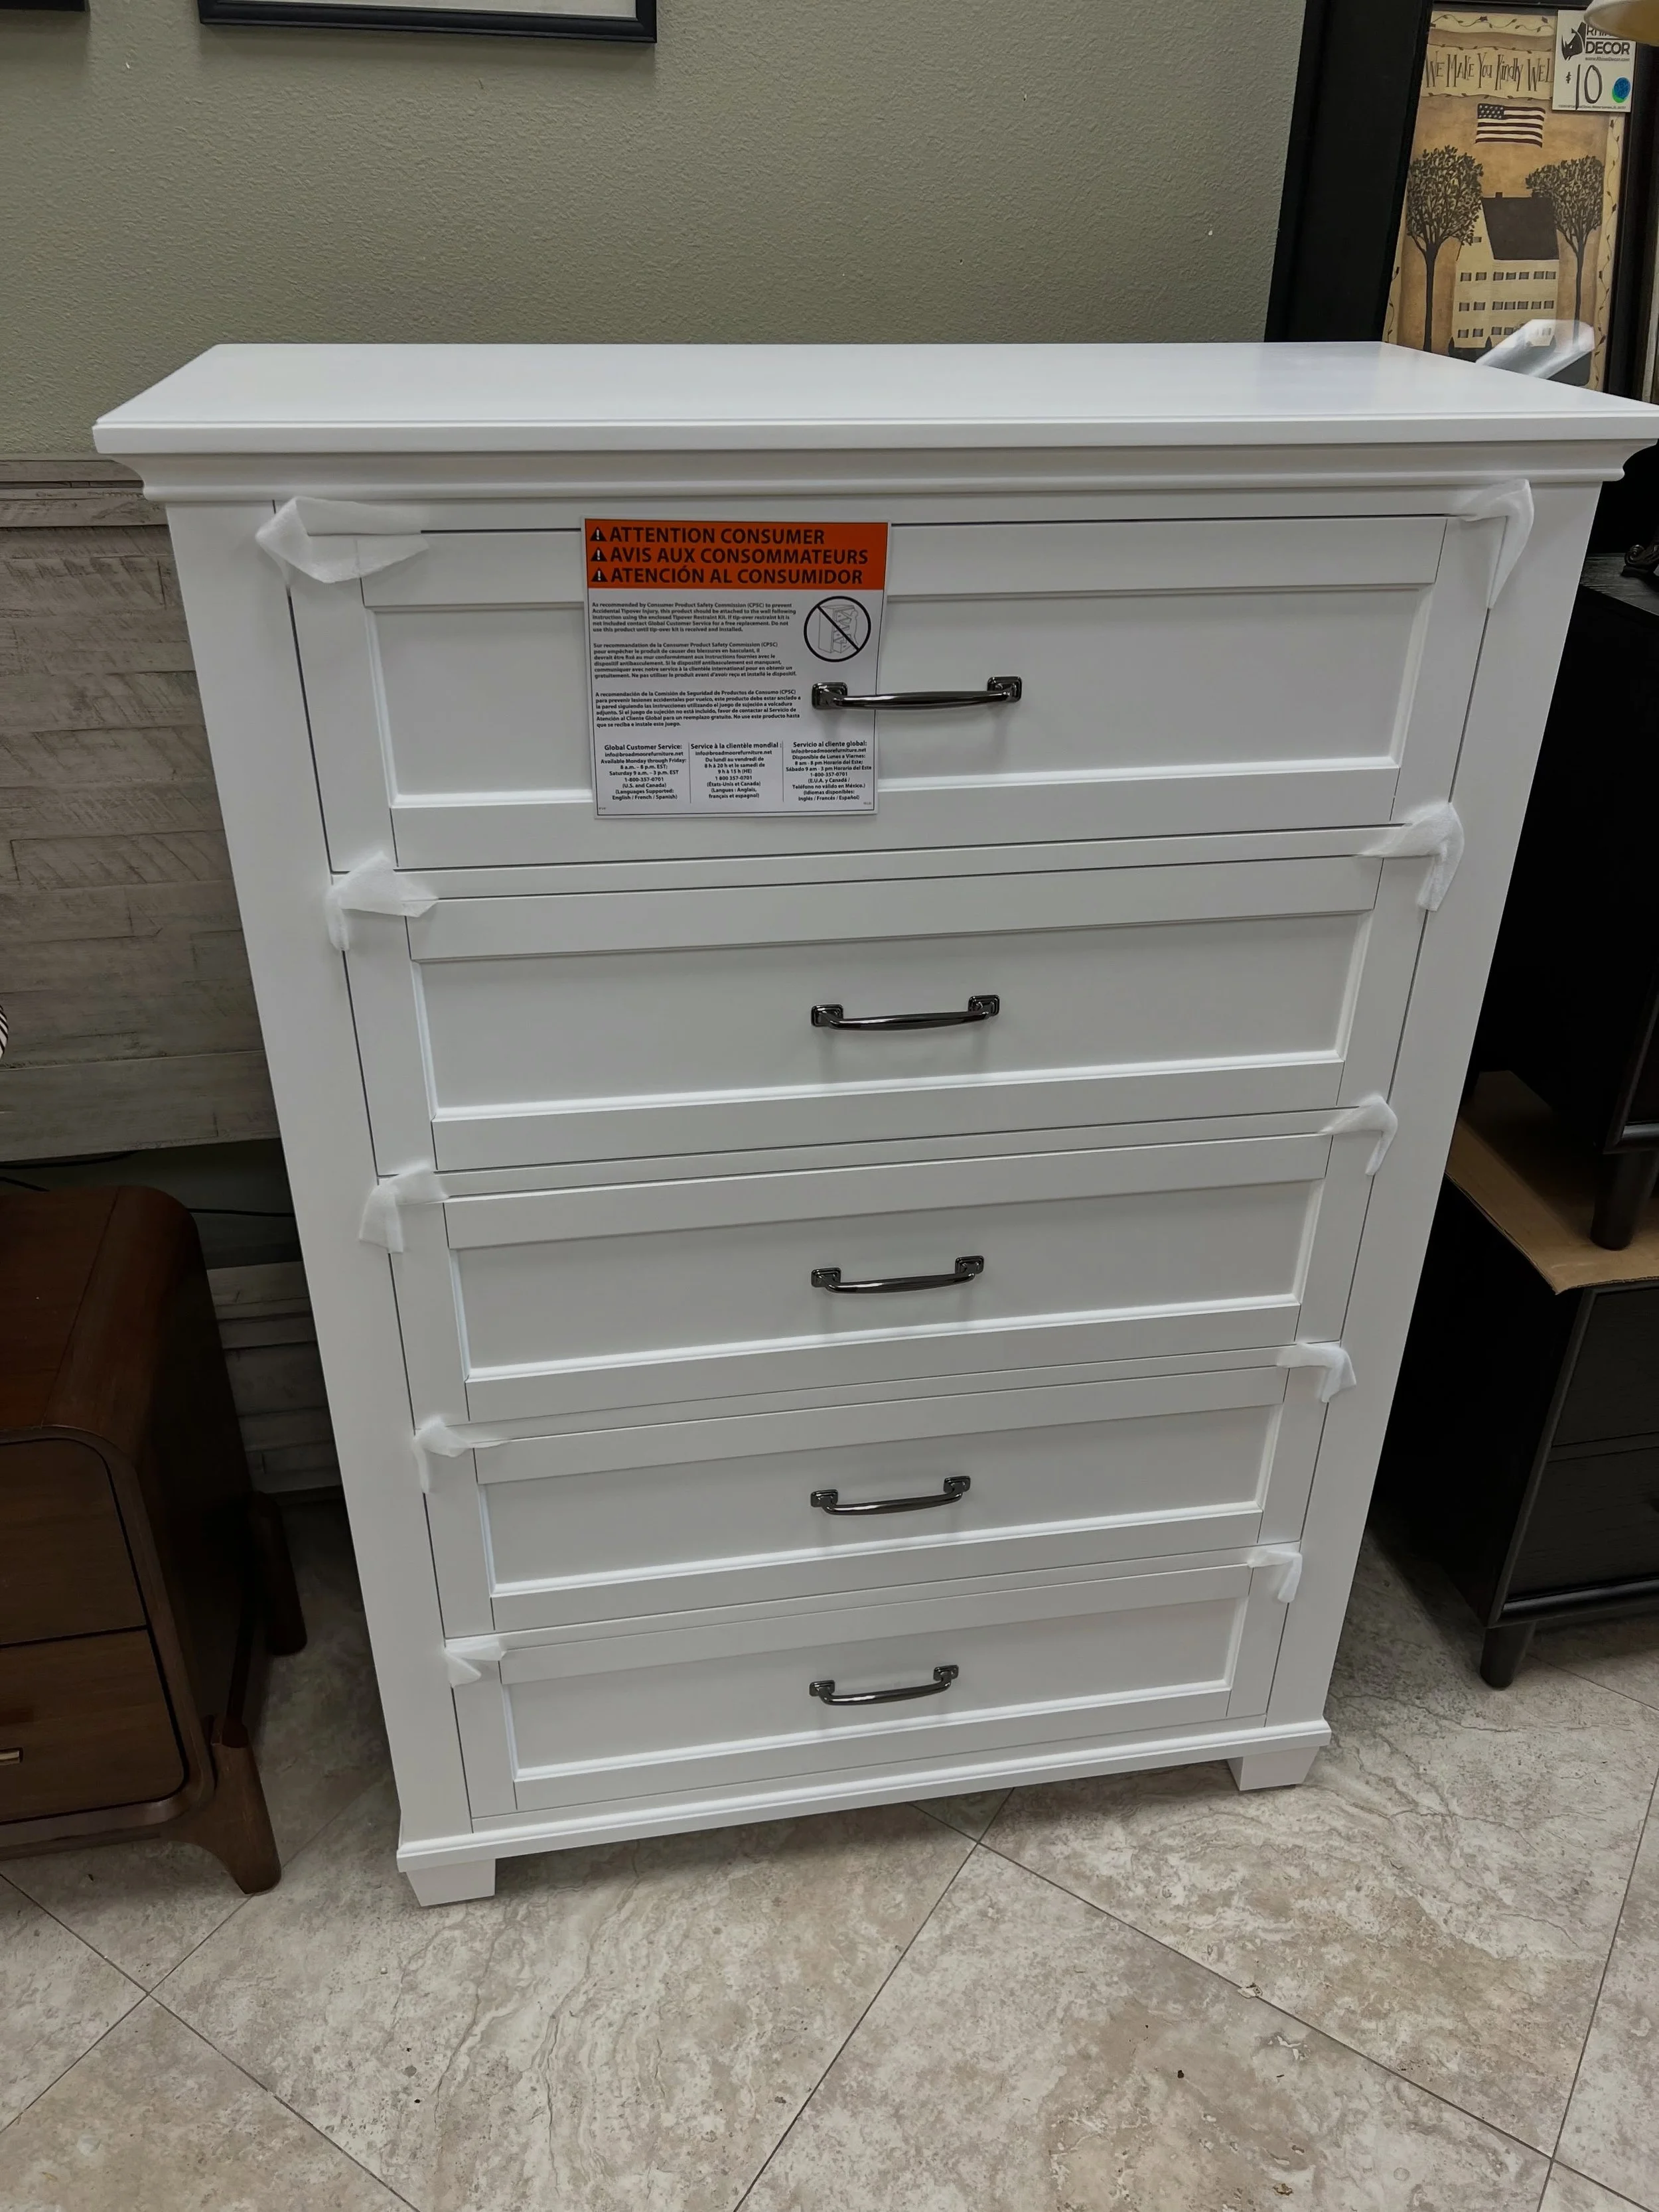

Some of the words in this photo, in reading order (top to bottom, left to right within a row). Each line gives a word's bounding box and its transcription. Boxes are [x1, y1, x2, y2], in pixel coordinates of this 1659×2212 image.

[1585, 41, 1630, 55] DECOR
[1424, 50, 1445, 88] WE
[1494, 54, 1524, 92] Kindly
[1527, 58, 1553, 92] WEL
[610, 526, 715, 544] ATTENTION
[721, 528, 825, 544] CONSUMER
[611, 547, 652, 563] AVIS
[657, 548, 695, 563] AUX
[701, 548, 869, 564] CONSOMMATEURS
[611, 565, 703, 583] ATENCIÓN
[710, 569, 733, 583] AL
[738, 569, 863, 584] CONSUMIDOR
